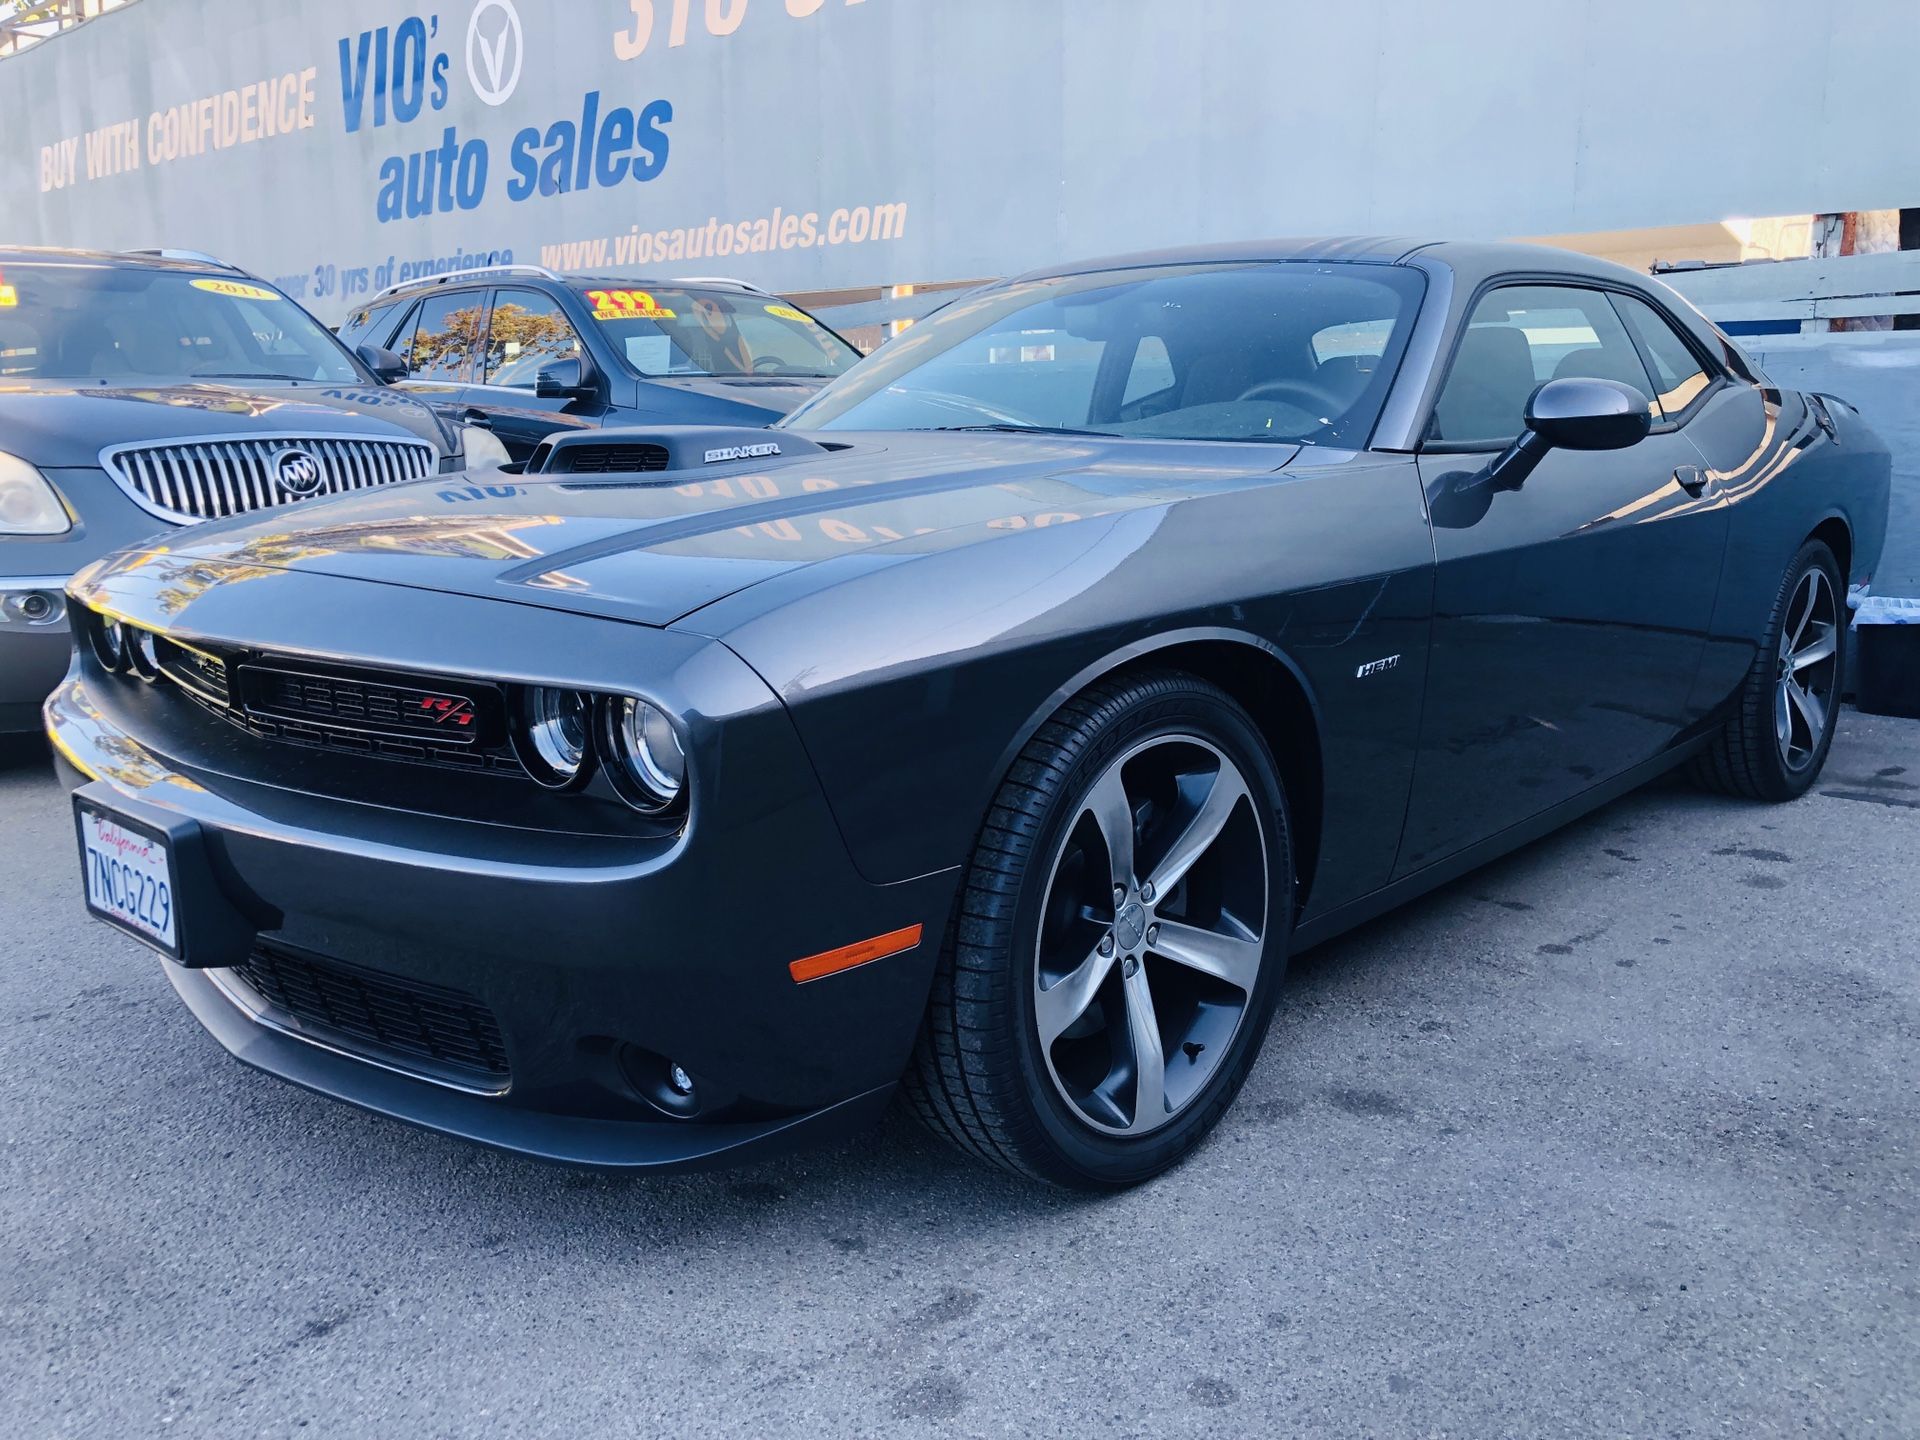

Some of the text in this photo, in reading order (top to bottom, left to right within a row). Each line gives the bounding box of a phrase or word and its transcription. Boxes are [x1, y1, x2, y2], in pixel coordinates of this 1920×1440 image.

[338, 15, 449, 133] VIO's
[41, 66, 316, 192] BUY WITH CONFIDENCE
[377, 90, 673, 223] auto sales
[541, 202, 907, 272] www.viosautosales.com
[211, 282, 262, 297] 2011
[314, 264, 336, 297] 30
[341, 267, 369, 302] yrs
[375, 255, 395, 292] of
[597, 310, 667, 319] WE FINANCE
[705, 443, 781, 463] SHAKER
[421, 697, 474, 725] R/T
[88, 847, 170, 933] 7NCG229
